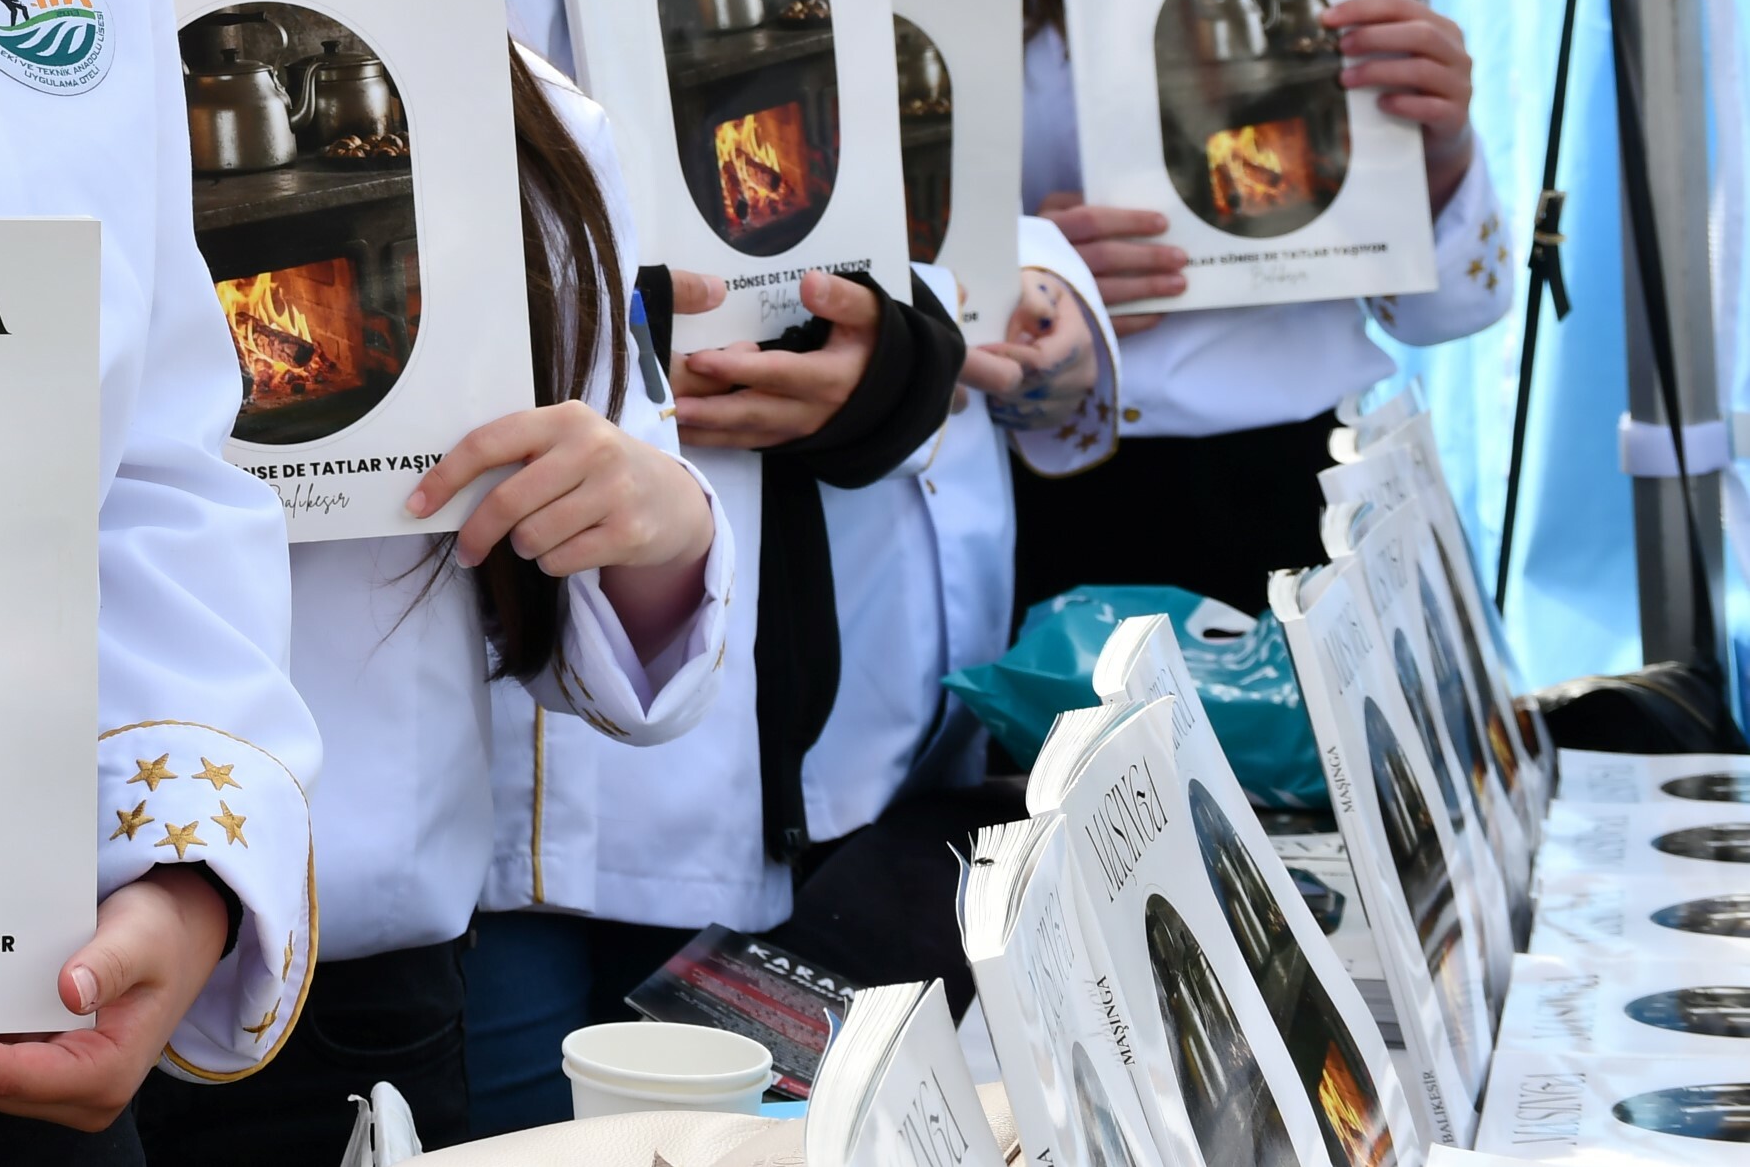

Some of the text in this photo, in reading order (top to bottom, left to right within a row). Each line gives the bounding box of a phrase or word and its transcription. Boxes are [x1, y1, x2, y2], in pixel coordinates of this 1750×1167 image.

[19, 61, 34, 71] VE
[36, 66, 71, 77] TEKNİK
[73, 44, 103, 74] ANADOLU
[24, 70, 79, 88] UYGULAMA
[733, 274, 766, 290] SÖNSE
[769, 272, 781, 285] DE
[283, 463, 306, 478] DE
[310, 457, 381, 476] TATLAR
[386, 453, 448, 474] YAŞIY
[1097, 975, 1135, 1065] MAŞINGA
